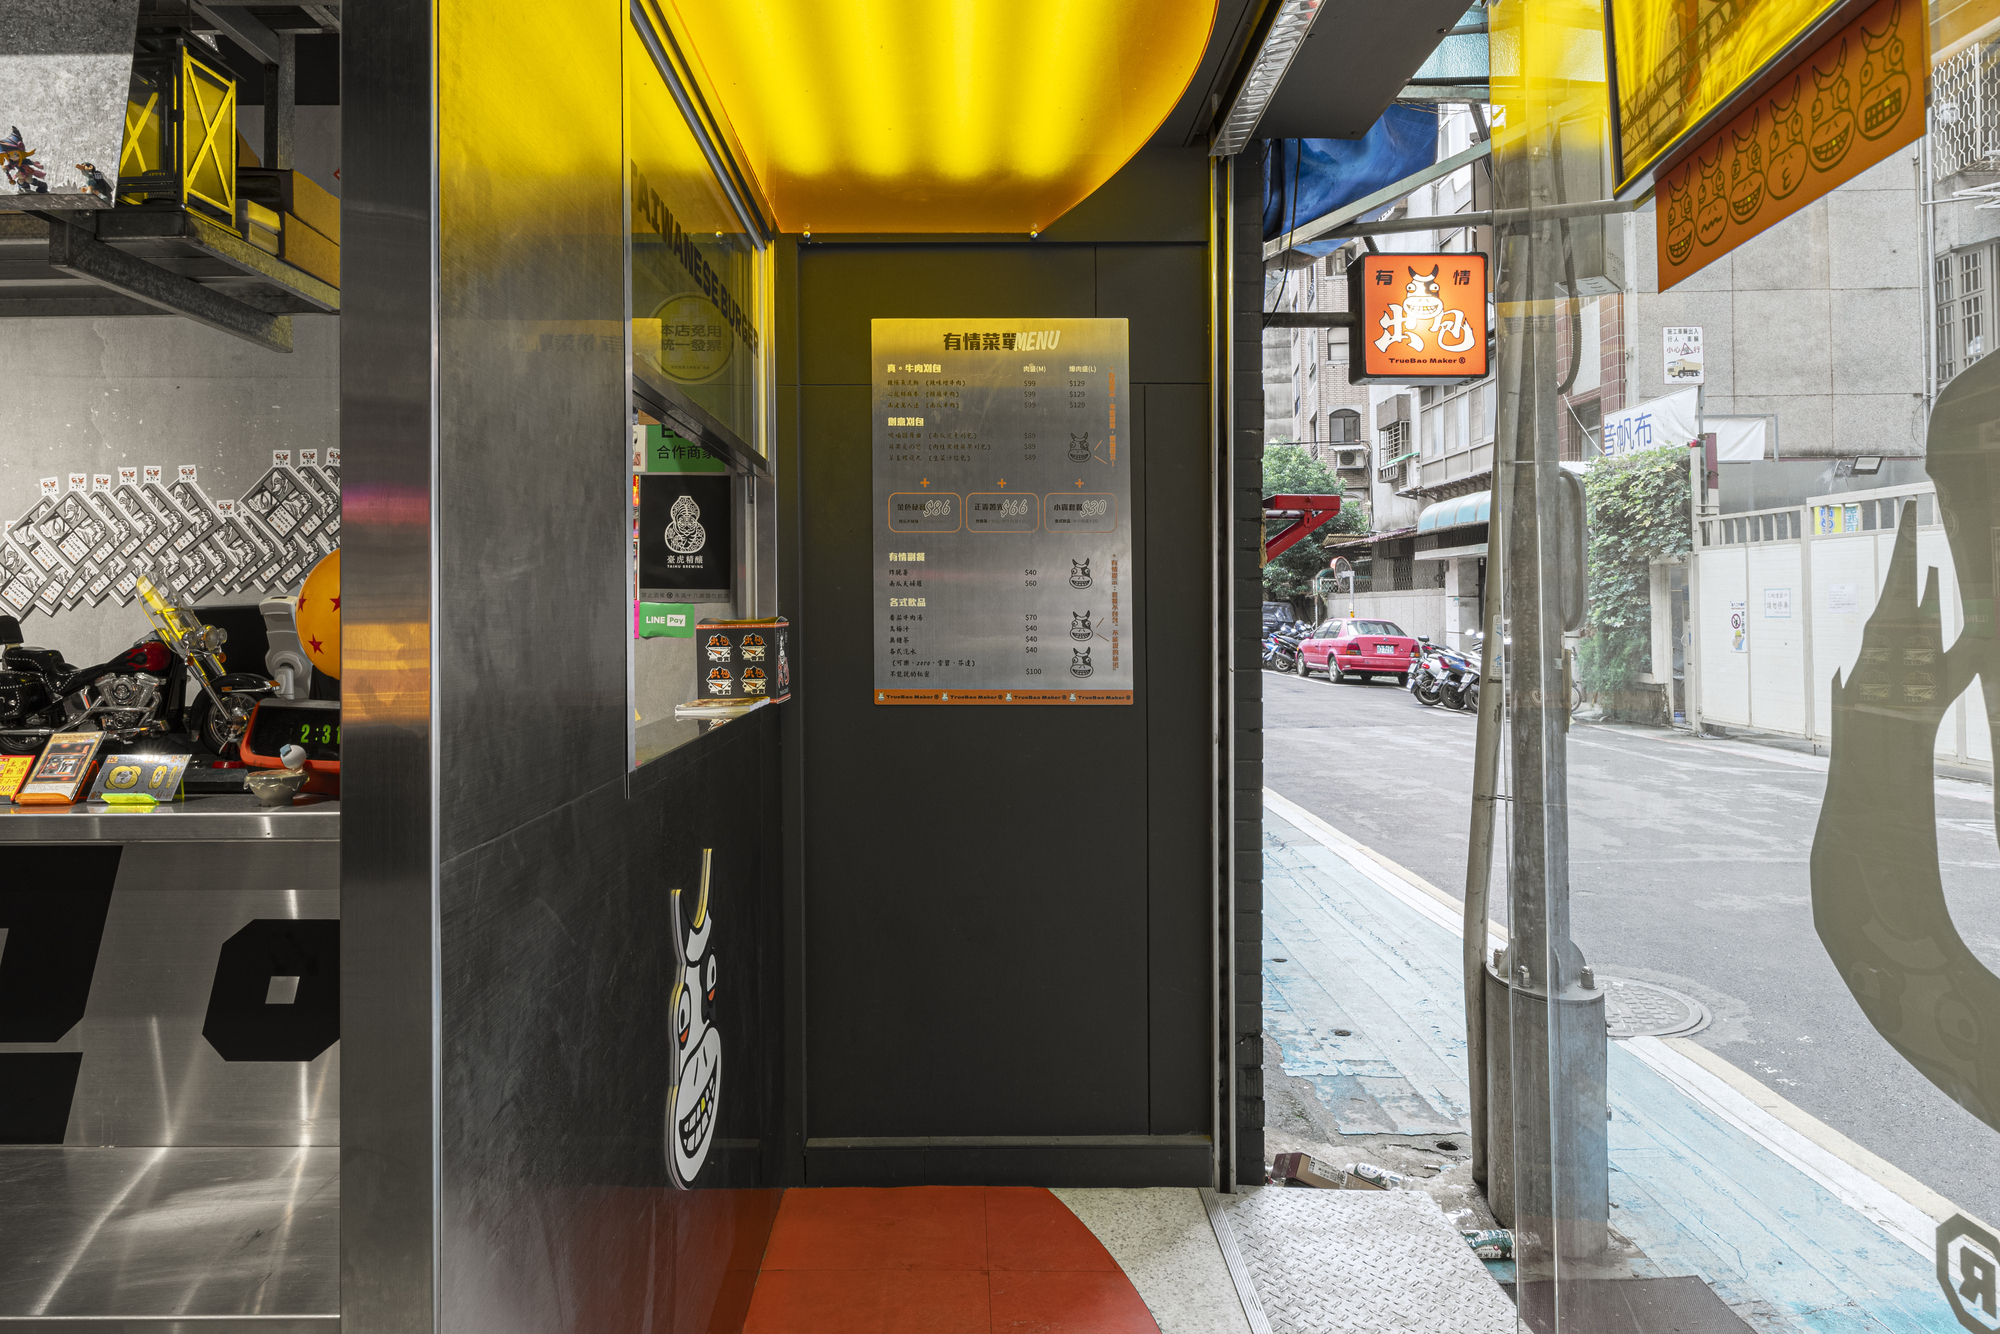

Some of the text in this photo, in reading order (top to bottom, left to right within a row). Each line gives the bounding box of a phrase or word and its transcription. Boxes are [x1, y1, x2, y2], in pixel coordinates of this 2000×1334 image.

[1376, 270, 1471, 286] 有 情
[720, 283, 759, 358] BURGER
[661, 325, 722, 337] 本店免用
[661, 339, 722, 352] 統一發票
[943, 329, 1060, 352] 有情菜單 MENU
[1024, 401, 1037, 409] $99
[1069, 401, 1086, 409] $129
[922, 498, 952, 518] $86
[999, 498, 1029, 519] $66
[1079, 498, 1108, 518] $30
[666, 554, 704, 564] 臺虎精釀
[889, 597, 927, 607] 各式飲品
[645, 615, 684, 625] LINE Pay
